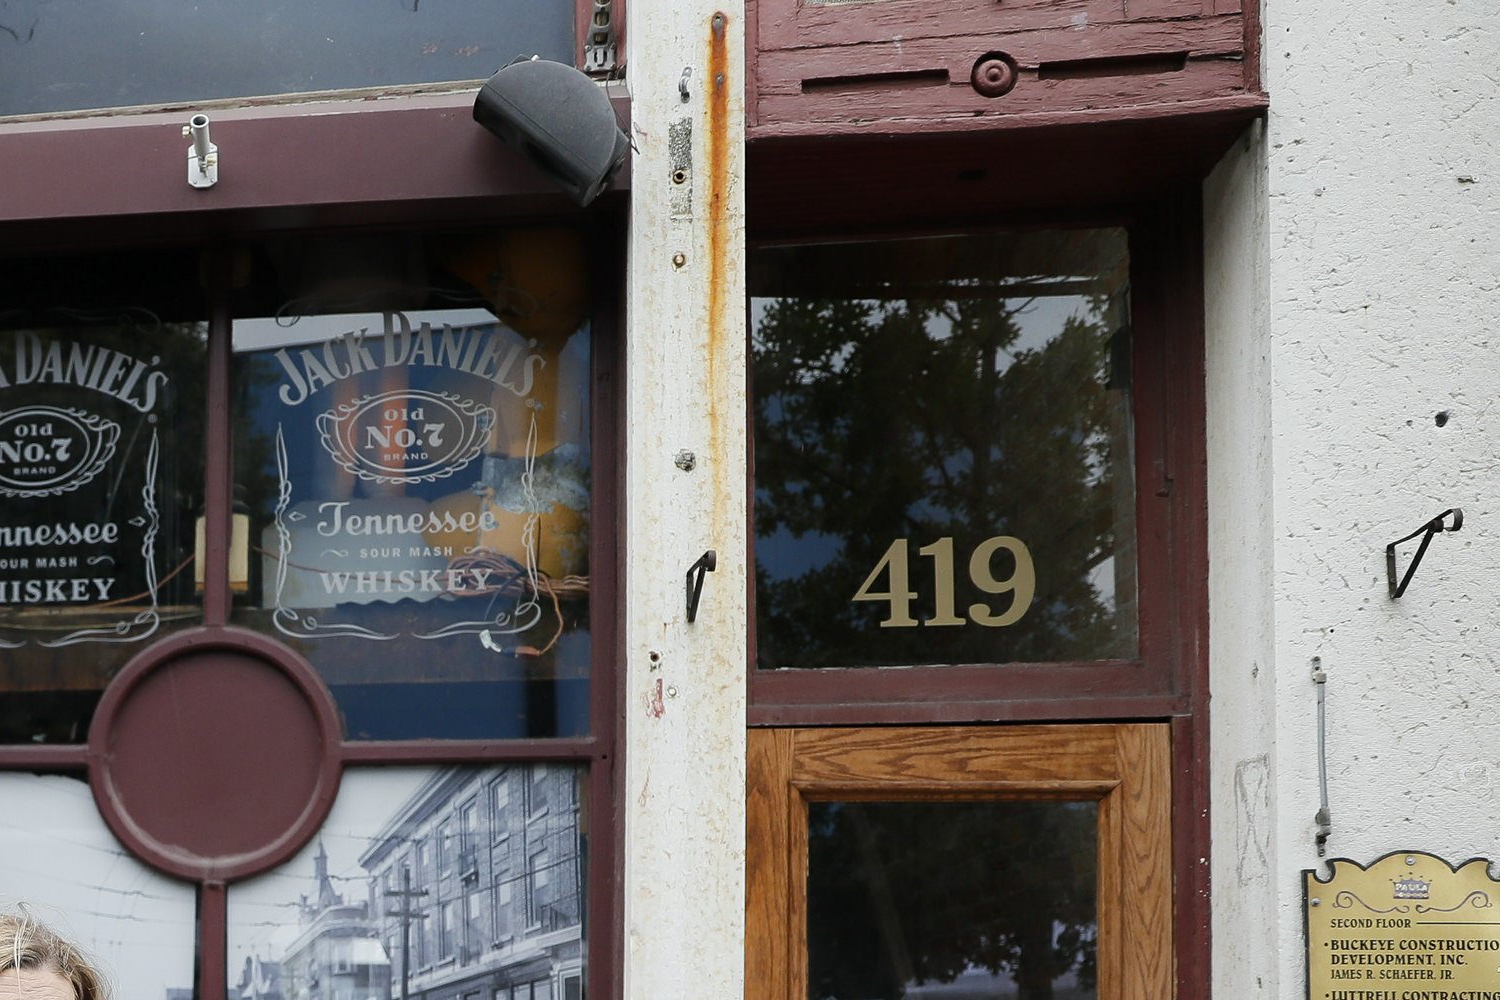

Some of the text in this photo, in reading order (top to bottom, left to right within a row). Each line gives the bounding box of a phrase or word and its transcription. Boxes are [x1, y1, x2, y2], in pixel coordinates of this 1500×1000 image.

[274, 310, 546, 405] JACK DANIEL'S
[15, 330, 169, 414] DANIEL'S
[383, 451, 428, 461] BRAND
[13, 465, 56, 476] BRAND
[317, 501, 496, 537] Tennessee
[360, 546, 453, 558] SOUR MASH
[36, 557, 78, 568] MASH
[319, 567, 494, 595] WHISKEY
[851, 535, 1036, 628] 419
[1330, 918, 1412, 929] SECOND FLOOR
[1331, 939, 1395, 951] BUCKEYE
[1440, 954, 1468, 966] INC.
[1331, 969, 1364, 980] JAMES
[1366, 970, 1376, 980] R.
[1440, 970, 1455, 980] JR.
